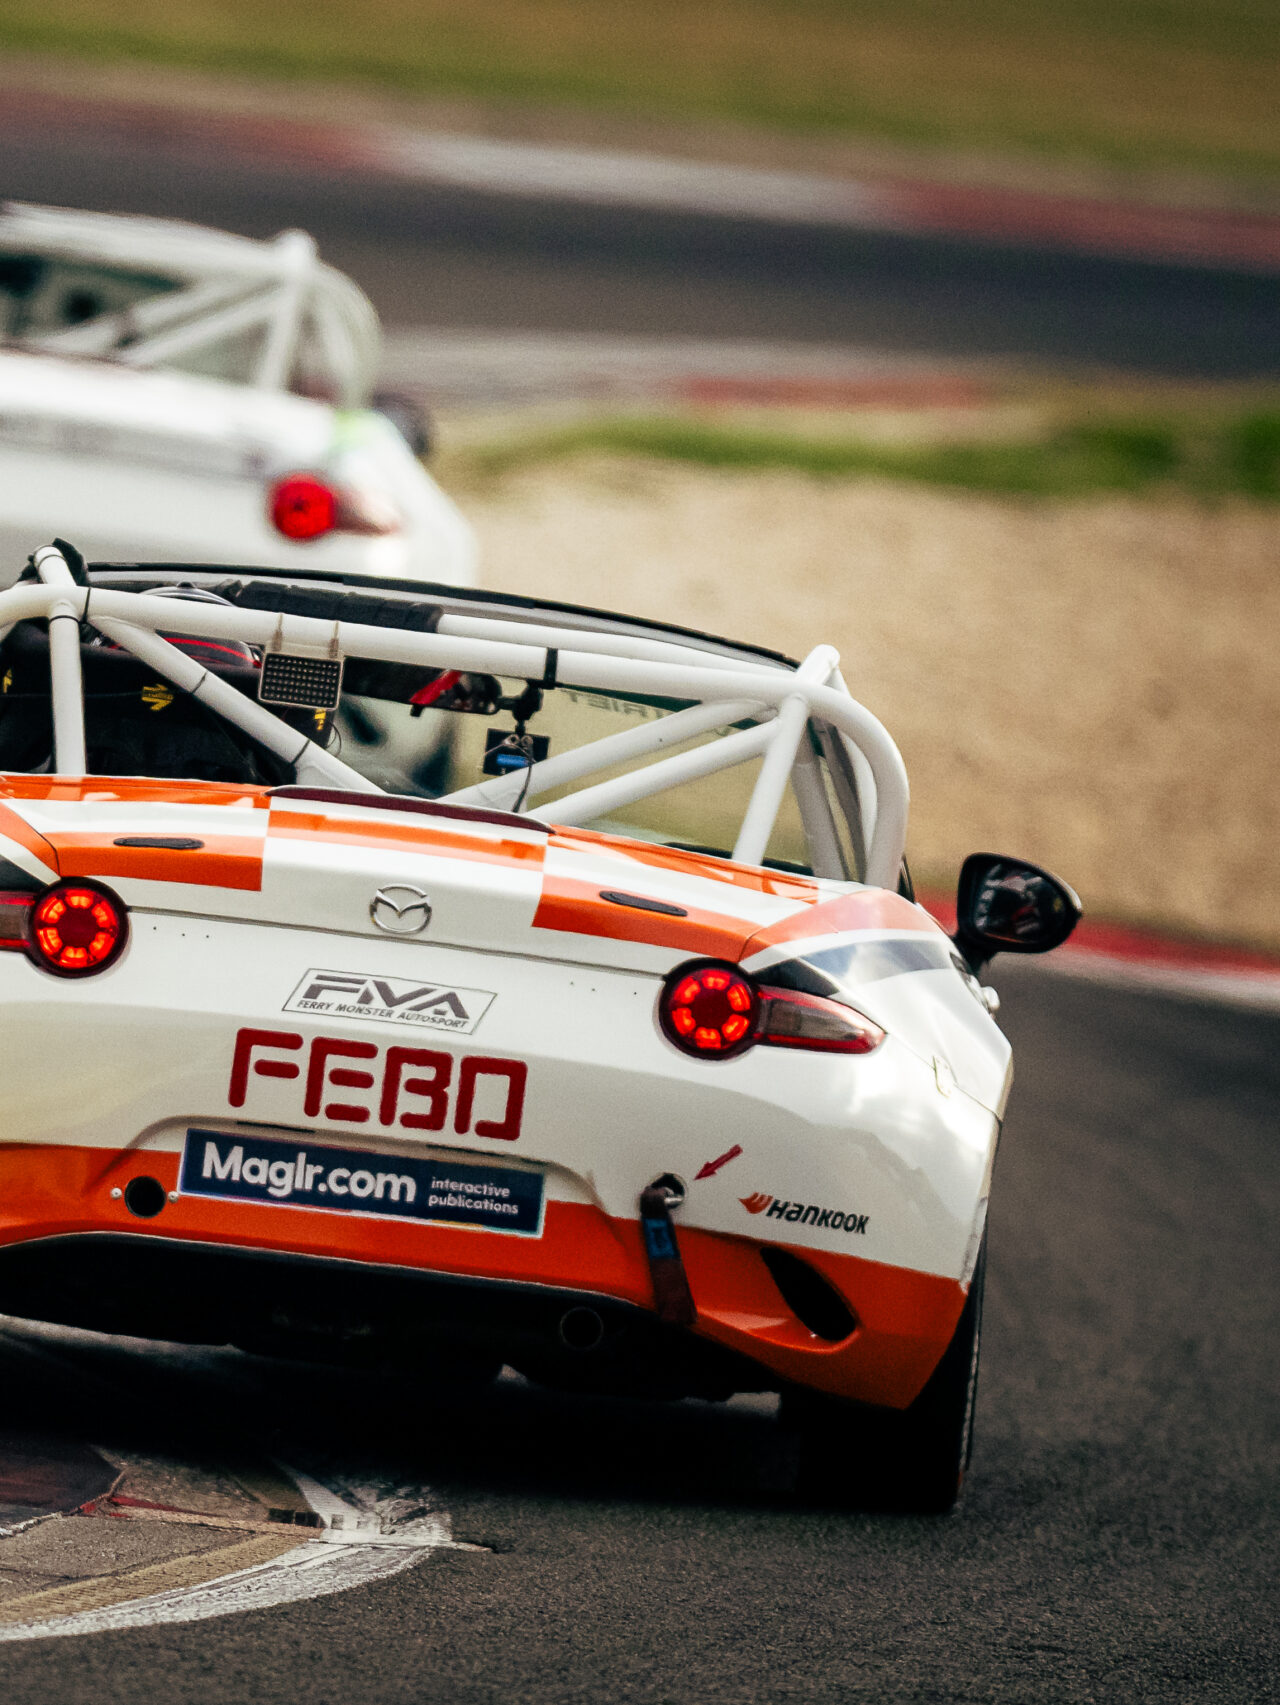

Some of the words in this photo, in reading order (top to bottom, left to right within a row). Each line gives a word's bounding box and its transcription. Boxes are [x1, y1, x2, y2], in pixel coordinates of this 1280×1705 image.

[297, 1000, 331, 1012] FERRY
[336, 1004, 395, 1018] MONSTER
[397, 1012, 469, 1028] AUTOSPORT
[228, 1027, 528, 1141] FEBO
[202, 1141, 417, 1203] Maglr.com
[431, 1176, 510, 1198] interactive
[428, 1193, 519, 1215] publications
